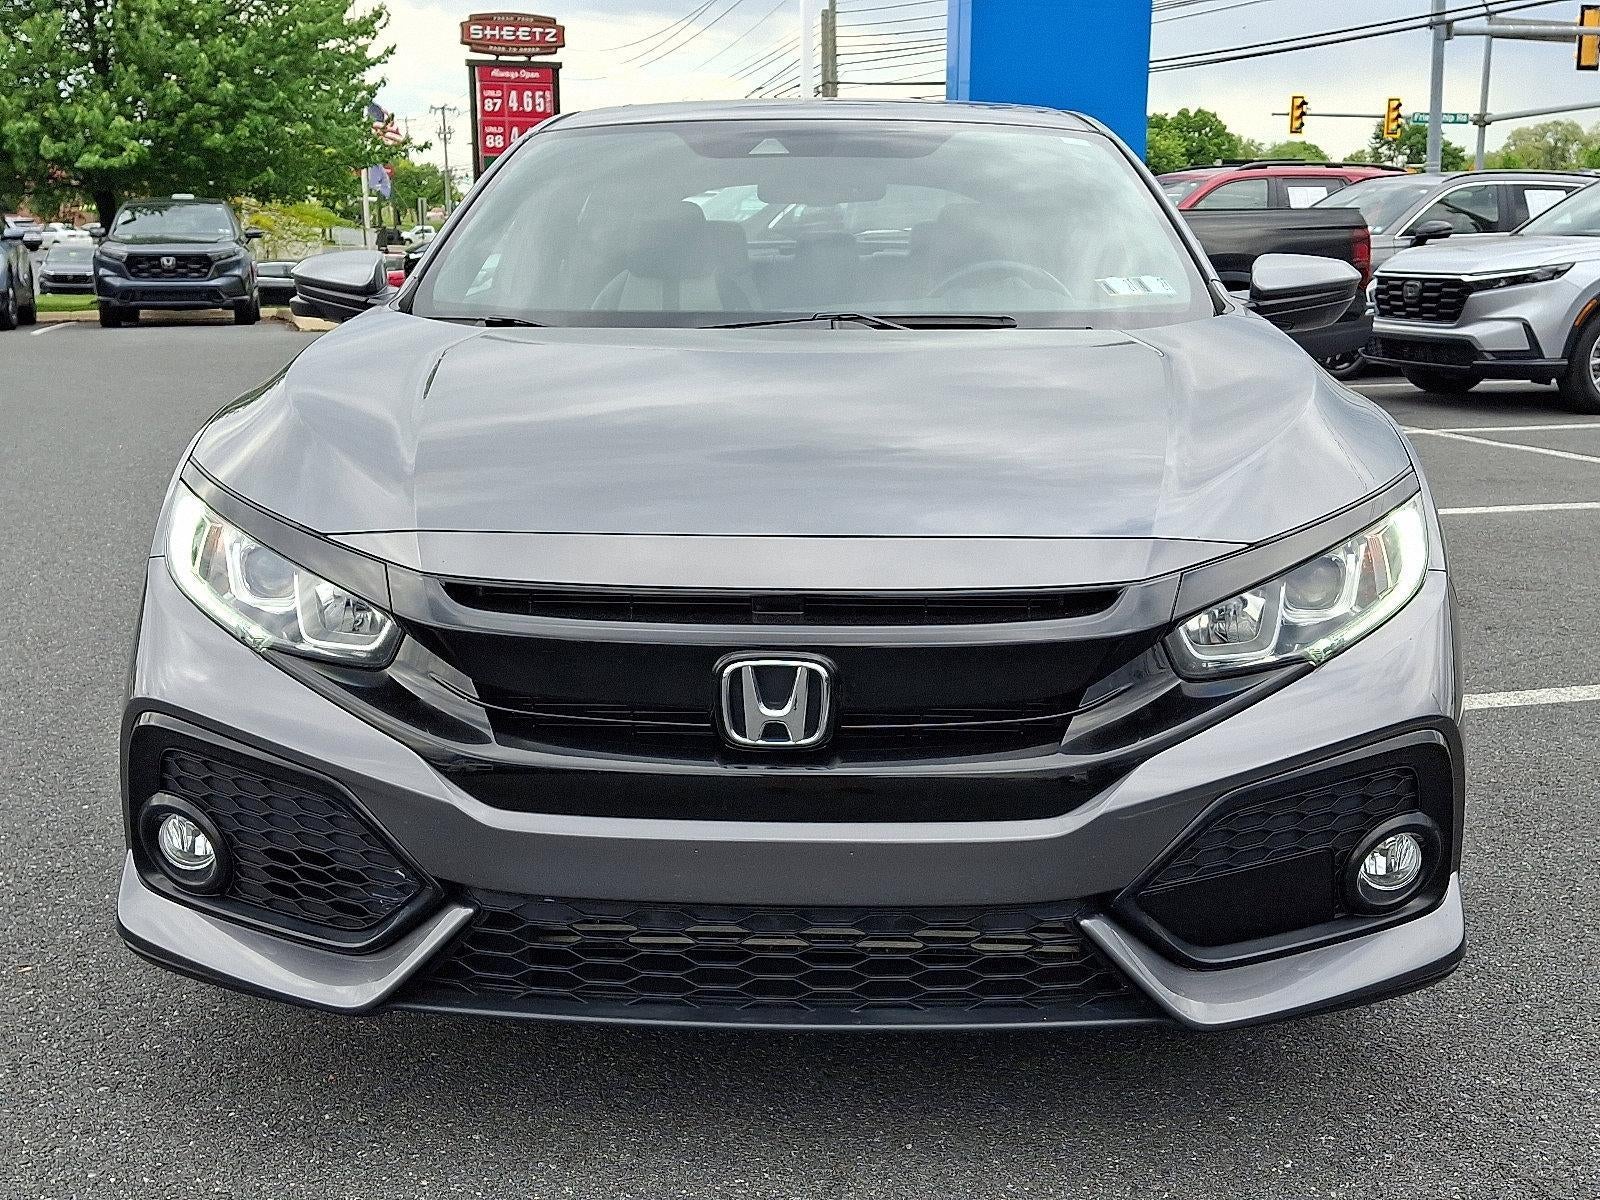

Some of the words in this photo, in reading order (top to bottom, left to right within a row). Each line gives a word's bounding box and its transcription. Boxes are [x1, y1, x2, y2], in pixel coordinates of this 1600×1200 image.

[469, 24, 557, 42] SHEETZ
[491, 68, 519, 80] Always
[520, 69, 540, 80] Open
[484, 98, 502, 112] 87
[485, 134, 504, 148] 88
